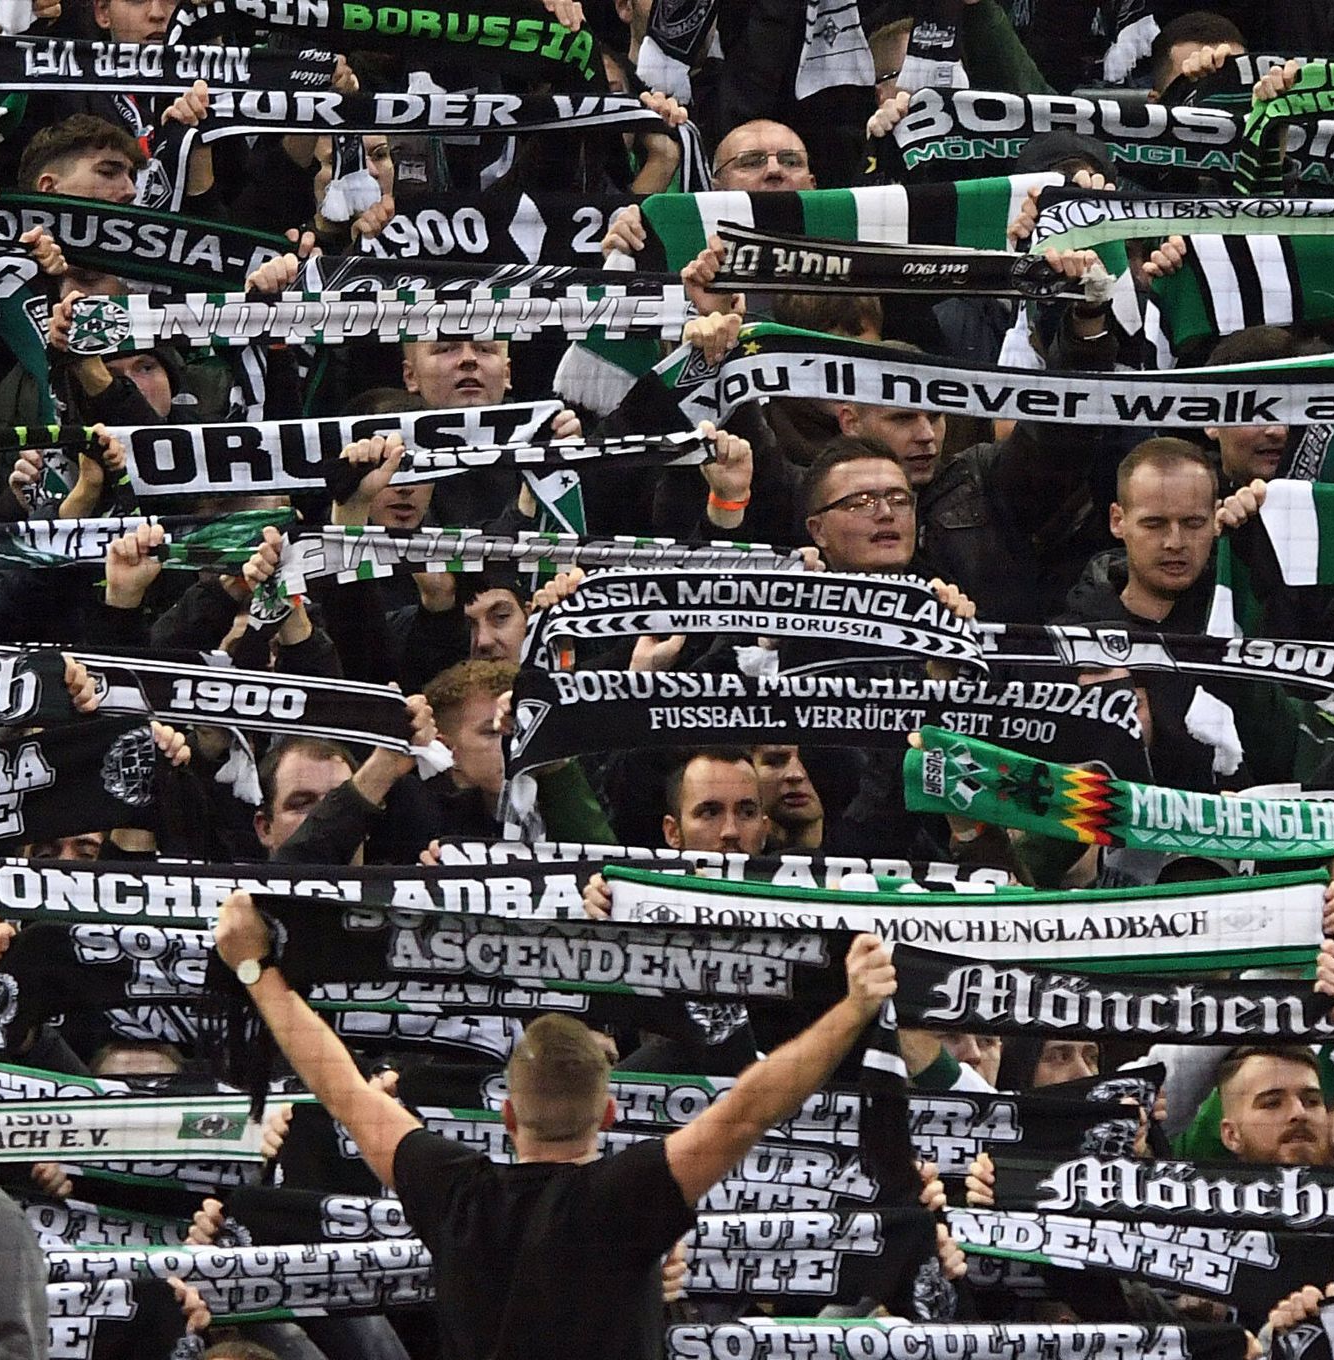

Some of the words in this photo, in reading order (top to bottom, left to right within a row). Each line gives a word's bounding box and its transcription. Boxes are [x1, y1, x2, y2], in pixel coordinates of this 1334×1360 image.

[92, 42, 164, 78] DER
[374, 92, 519, 127] DER
[881, 372, 1091, 419] never
[1113, 389, 1280, 424] walk
[669, 614, 713, 629] WIR
[718, 614, 769, 629] SIND
[775, 617, 883, 640] BORUSSIA
[169, 678, 308, 720] 1900
[941, 710, 993, 737] SEIT
[999, 716, 1058, 744] 1900
[874, 910, 1209, 945] MÖNCHENGLADBACH
[59, 1127, 110, 1149] E.V.
